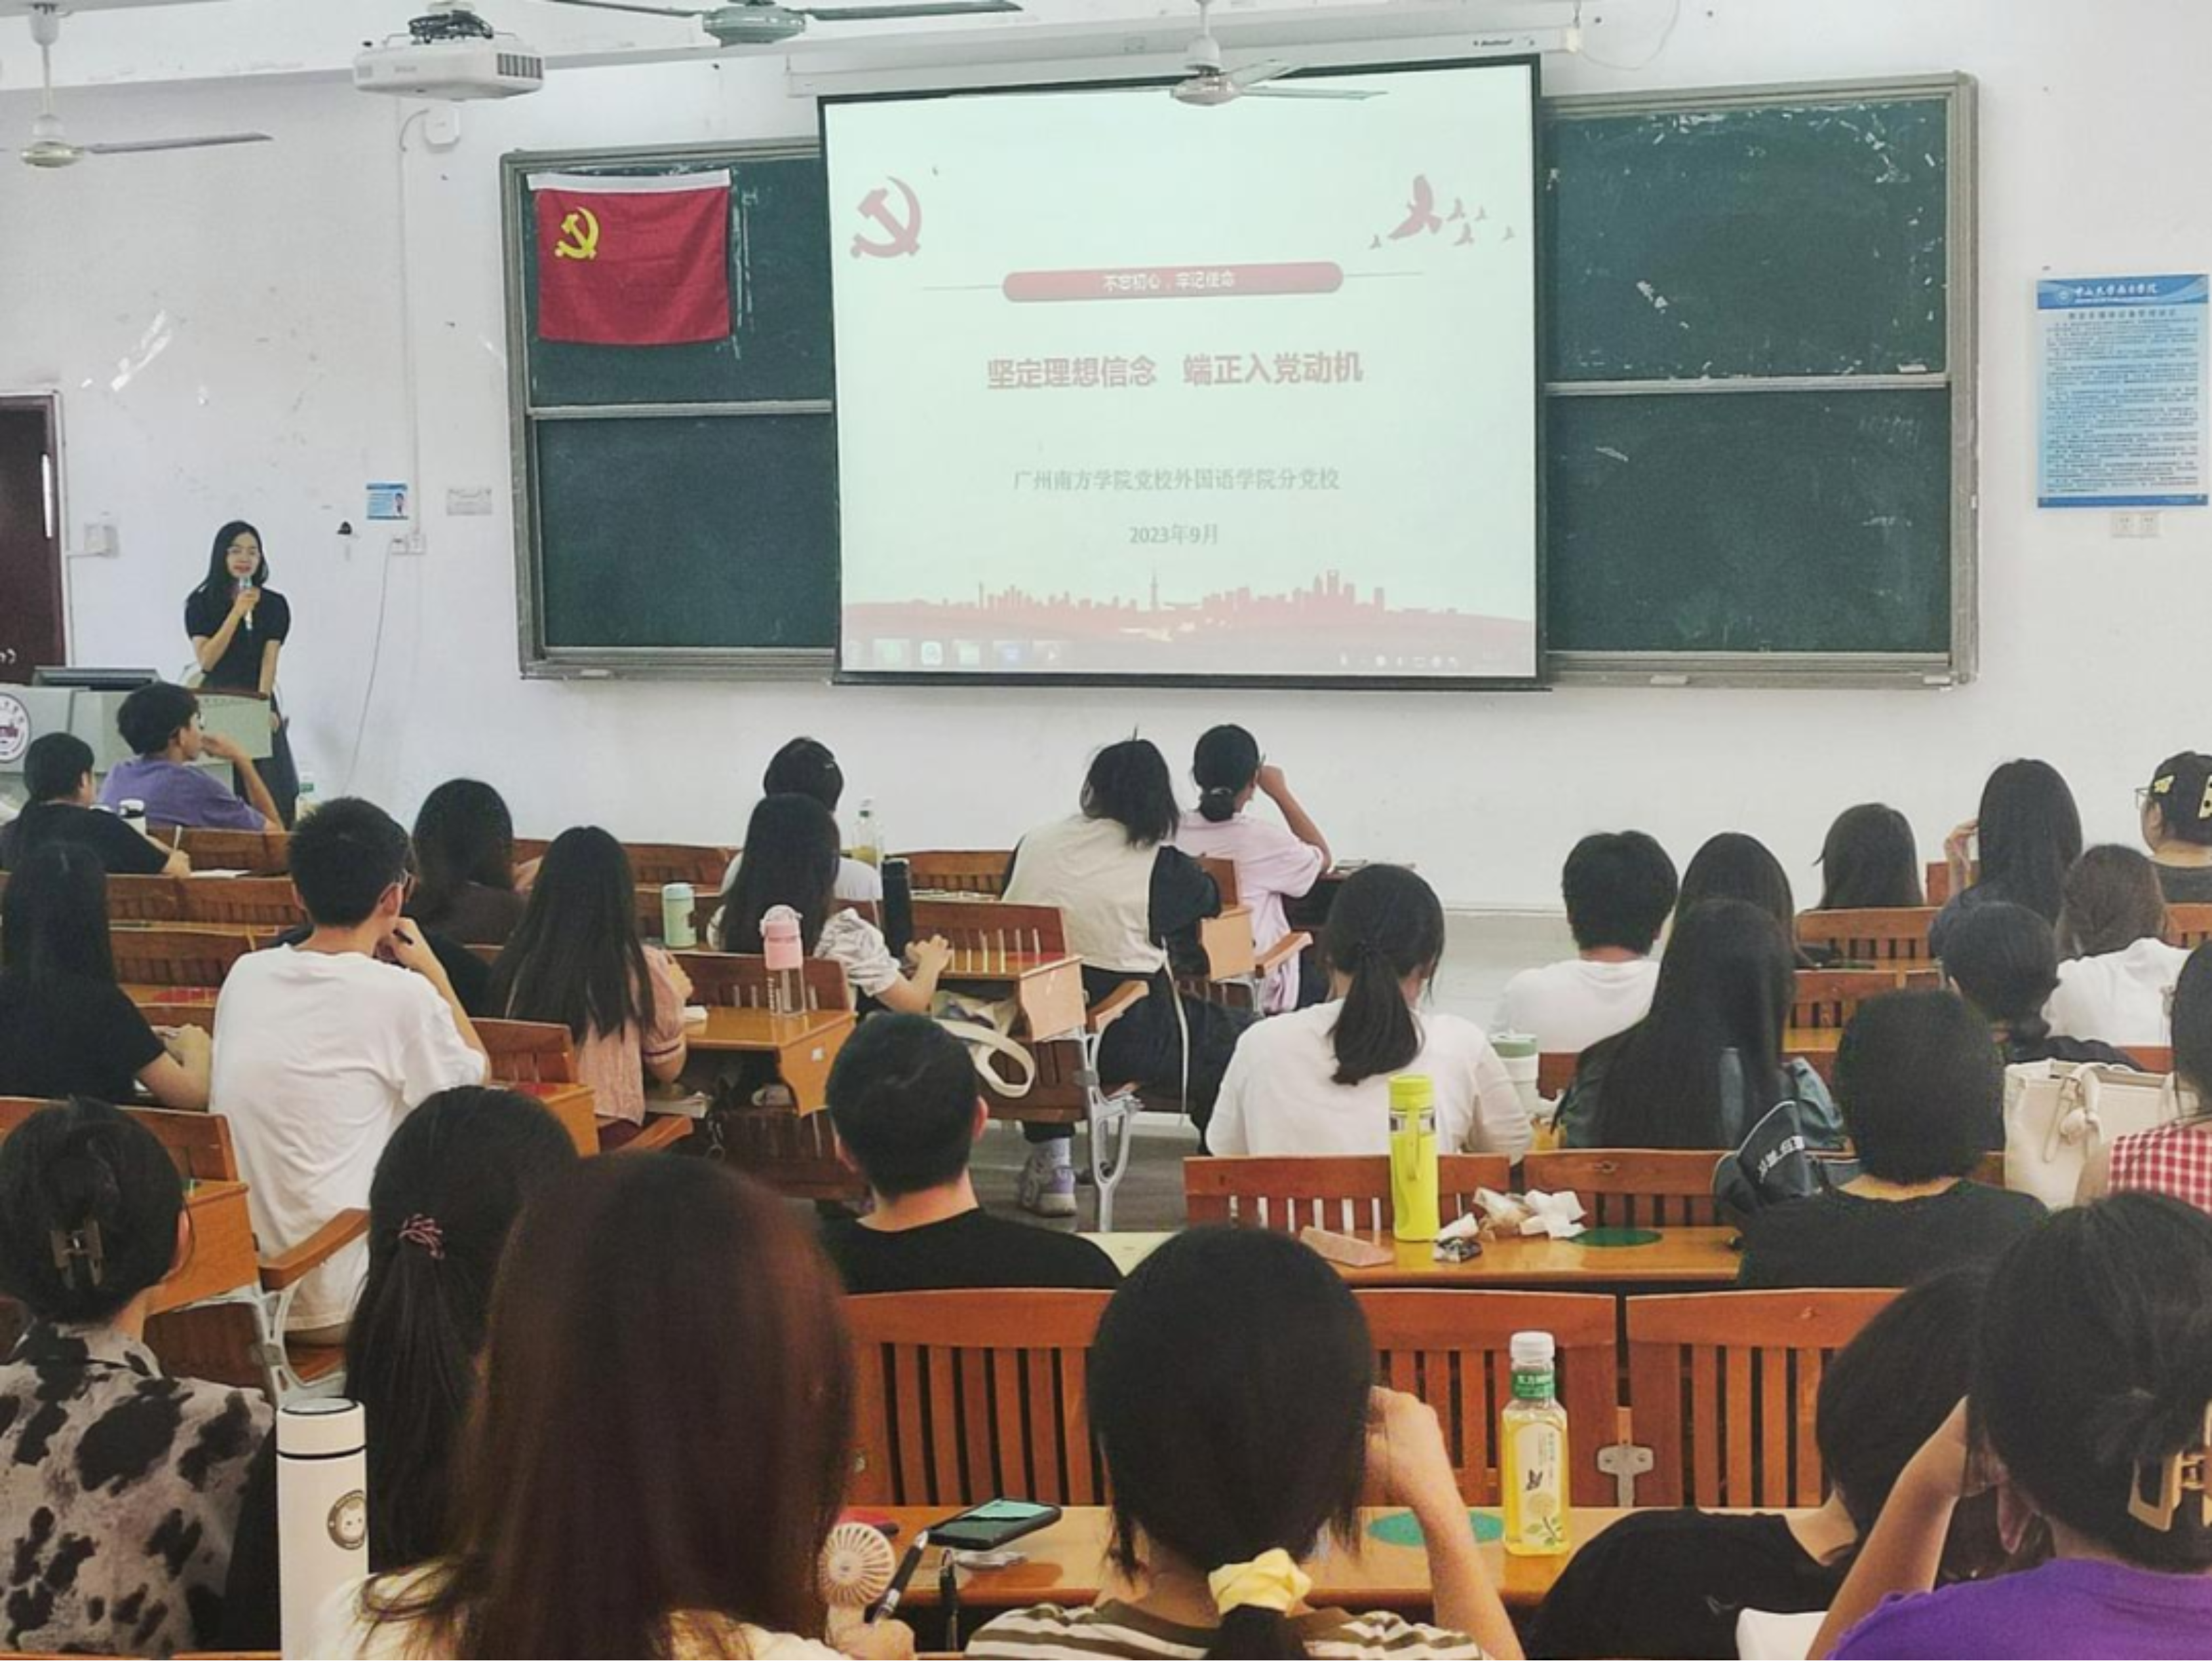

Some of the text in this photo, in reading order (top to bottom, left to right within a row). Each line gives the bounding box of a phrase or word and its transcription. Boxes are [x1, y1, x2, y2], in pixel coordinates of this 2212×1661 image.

[987, 351, 1364, 389] 坚定理想信念 端正入党动机
[1013, 467, 1341, 491] 广州南方学院党校外国语学院分党校
[1129, 523, 1219, 545] 2023年9月
